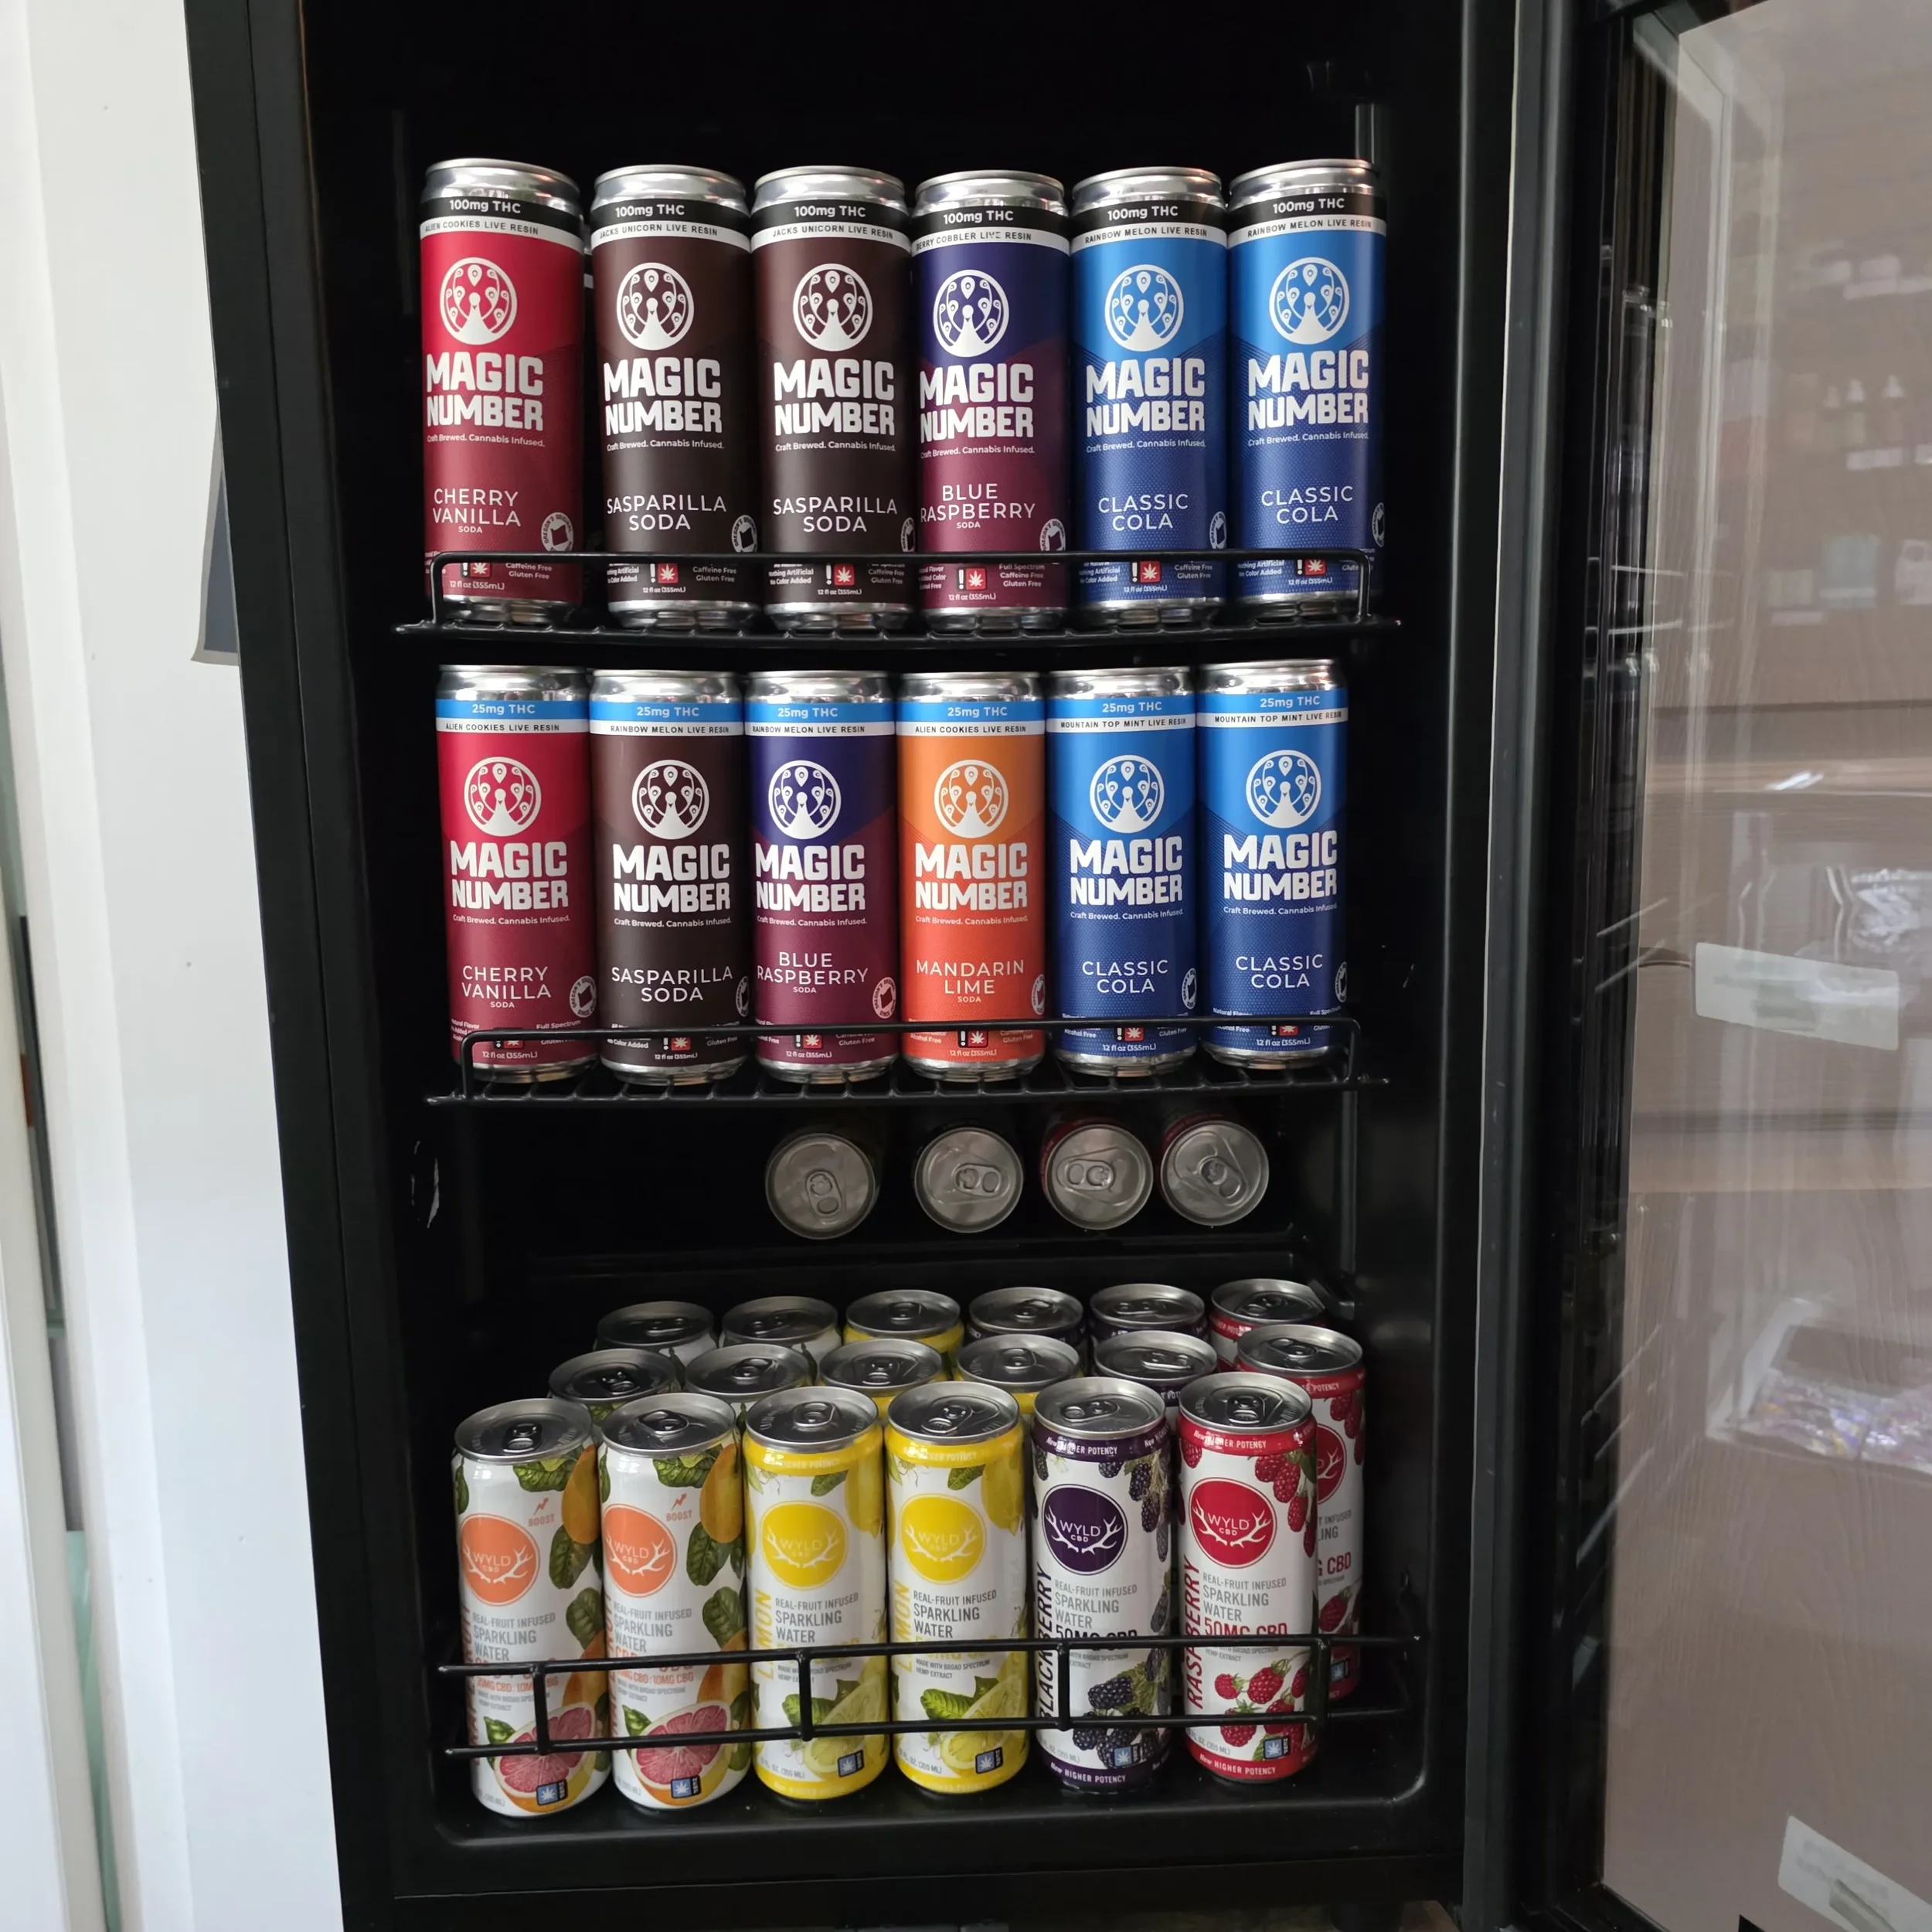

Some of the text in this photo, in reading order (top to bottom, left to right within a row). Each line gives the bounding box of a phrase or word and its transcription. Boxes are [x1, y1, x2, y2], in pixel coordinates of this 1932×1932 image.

[450, 199, 521, 213] 100mg THC
[616, 204, 685, 217] 100mg THC
[794, 205, 866, 217] 100mg THC
[1107, 206, 1178, 220] 100mg THC
[1273, 198, 1345, 213] 100mg THC
[943, 210, 1013, 225] 100mg THC
[425, 220, 539, 235] ALIEN COOKIES LIVE RESIN
[773, 225, 893, 239] JACKS UNICORN LIVE RESIN
[1085, 226, 1207, 243] RAINBOW MELON LIVE RESIN
[427, 351, 544, 396] MAGIC
[603, 356, 722, 401] MAGIC
[773, 358, 895, 402] MAGIC
[1086, 356, 1206, 403] MAGIC
[1248, 349, 1369, 396] MAGIC
[919, 362, 1035, 410] MAGIC
[427, 394, 543, 432] NUMBER
[605, 398, 723, 436] NUMBER
[774, 400, 895, 436] NUMBER
[1087, 400, 1205, 437] NUMBER
[1248, 392, 1369, 430] NUMBER
[920, 406, 1035, 444] NUMBER
[776, 442, 791, 452] Craft
[793, 440, 827, 450] Brewed.
[828, 440, 868, 449] Cannabis
[434, 488, 519, 506] CHERRY
[942, 483, 998, 502] BLUE
[1261, 485, 1354, 507] CLASSIC
[606, 494, 727, 515] SASPARILLA
[772, 495, 898, 515] SASPARILLA
[920, 502, 1036, 523] RASPBERRY
[1098, 493, 1189, 514] CLASSIC
[432, 507, 522, 527] VANILLA
[628, 514, 691, 531] SODA
[803, 515, 867, 533] SODA
[1112, 513, 1174, 532] COLA
[1277, 505, 1338, 525] COLA
[472, 704, 536, 715] 25mg THC
[1102, 701, 1162, 714] 25mg THC
[1260, 696, 1321, 709] 25mg THC
[636, 706, 699, 718] 25mg THC
[777, 708, 838, 719] 25mg THC
[947, 706, 1008, 718] 25mg THC
[940, 725, 979, 733] COOKIES
[1060, 720, 1100, 729] MOUNTAIN
[1168, 717, 1186, 726] RESIN
[450, 839, 567, 879] MAGIC
[1070, 835, 1182, 875] MAGIC
[1223, 830, 1338, 870] MAGIC
[613, 843, 730, 881] MAGIC
[755, 842, 865, 880] MAGIC
[915, 842, 1028, 879] MAGIC
[1070, 874, 1182, 906] NUMBER
[1223, 868, 1337, 901] NUMBER
[451, 879, 569, 910] NUMBER
[614, 882, 730, 913] NUMBER
[757, 880, 866, 912] NUMBER
[915, 880, 1027, 911] NUMBER
[631, 919, 665, 927] Brewed.
[666, 919, 704, 927] Cannabis
[706, 917, 732, 926] Infused.
[916, 915, 1029, 925] Craft Brewed. Cannabis Infused.
[779, 951, 833, 968] BLUE
[917, 959, 1025, 977] MANDARIN
[1082, 959, 1168, 977] CLASSIC
[1236, 953, 1324, 971] CLASSIC
[462, 965, 549, 983] CHERRY
[611, 966, 733, 985] SASPARILLA
[757, 965, 868, 985] RASPBERRY
[1251, 972, 1311, 988] COLA
[461, 982, 552, 999] VANILLA
[640, 986, 703, 1002] SODA
[944, 978, 995, 995] LIME
[1097, 978, 1155, 994] COLA
[528, 1513, 556, 1527] BOOST
[666, 1509, 692, 1522] BOOST
[1207, 1514, 1250, 1531] WYLD
[1060, 1520, 1100, 1537] WYLD
[1219, 1527, 1238, 1536] CBD
[918, 1531, 960, 1546] WYLD
[1070, 1533, 1089, 1543] CBD
[614, 1541, 649, 1559] WYLD
[1055, 1580, 1137, 1597] REAL-FRUIT INFUSED
[1203, 1572, 1287, 1588] REAL-FRUIT INFUSED
[775, 1593, 859, 1611] REAL-FRUIT INFUSED
[913, 1589, 997, 1606] REAL-FRUIT INFUSED
[1055, 1592, 1120, 1613] SPARKLING
[1203, 1585, 1269, 1607] SPARKLING
[775, 1610, 842, 1628] SPARKLING
[913, 1603, 980, 1622] SPARKLING
[1056, 1611, 1092, 1629] WATER
[1203, 1604, 1242, 1622] WATER
[776, 1627, 815, 1643] WATER
[914, 1622, 953, 1638] WATER
[1199, 1753, 1277, 1776] New HIGHER POTENCY
[1065, 1768, 1092, 1782] HIGHER
[1095, 1774, 1126, 1784] POTENCY
